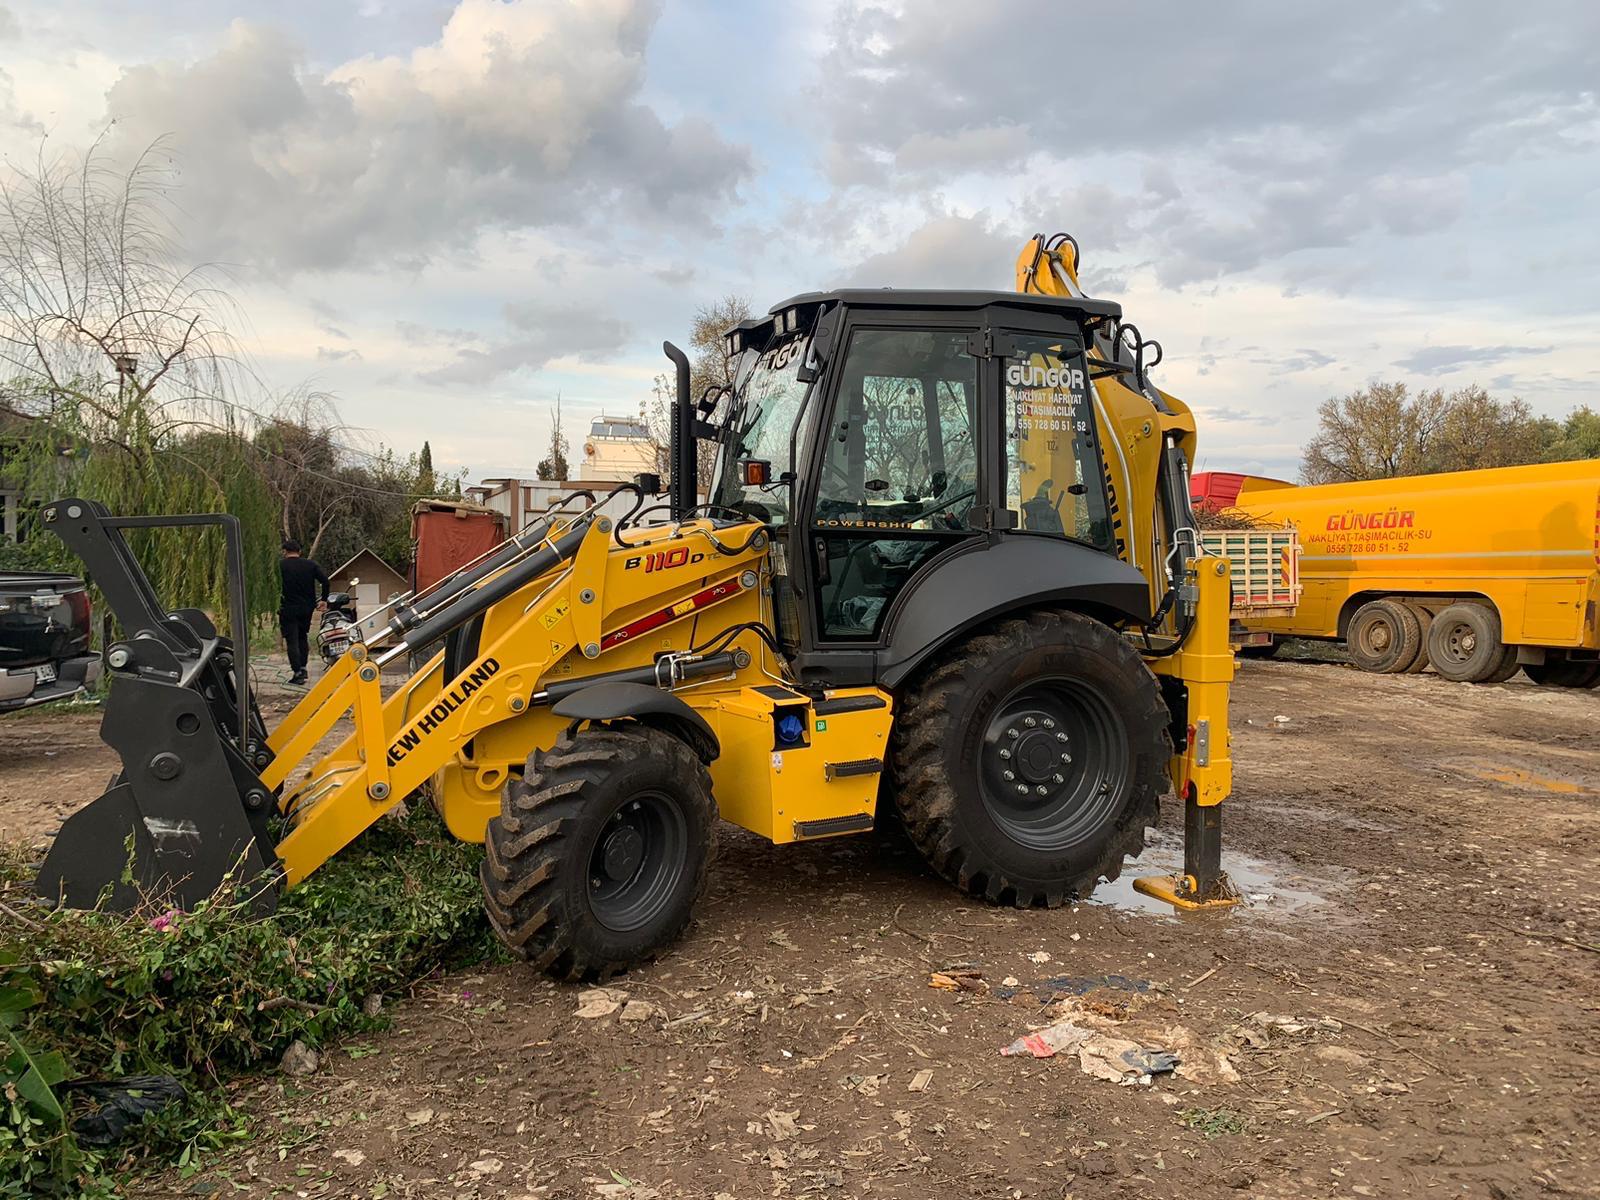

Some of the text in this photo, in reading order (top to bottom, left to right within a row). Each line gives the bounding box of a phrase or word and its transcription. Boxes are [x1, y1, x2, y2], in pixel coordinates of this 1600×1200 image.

[1016, 404, 1028, 415] SU
[1035, 420, 1048, 430] 728
[1050, 420, 1060, 430] 60
[1062, 420, 1070, 431] 51
[1077, 421, 1087, 432] 52
[817, 519, 928, 530] POWERSHIF
[1326, 507, 1415, 531] GÜNGÖR
[1326, 544, 1346, 554] 0555
[1348, 543, 1363, 553] 728
[1365, 543, 1376, 553] 60
[1379, 543, 1389, 553] 51
[1398, 542, 1409, 552] 52
[417, 657, 500, 735] HOLLAND
